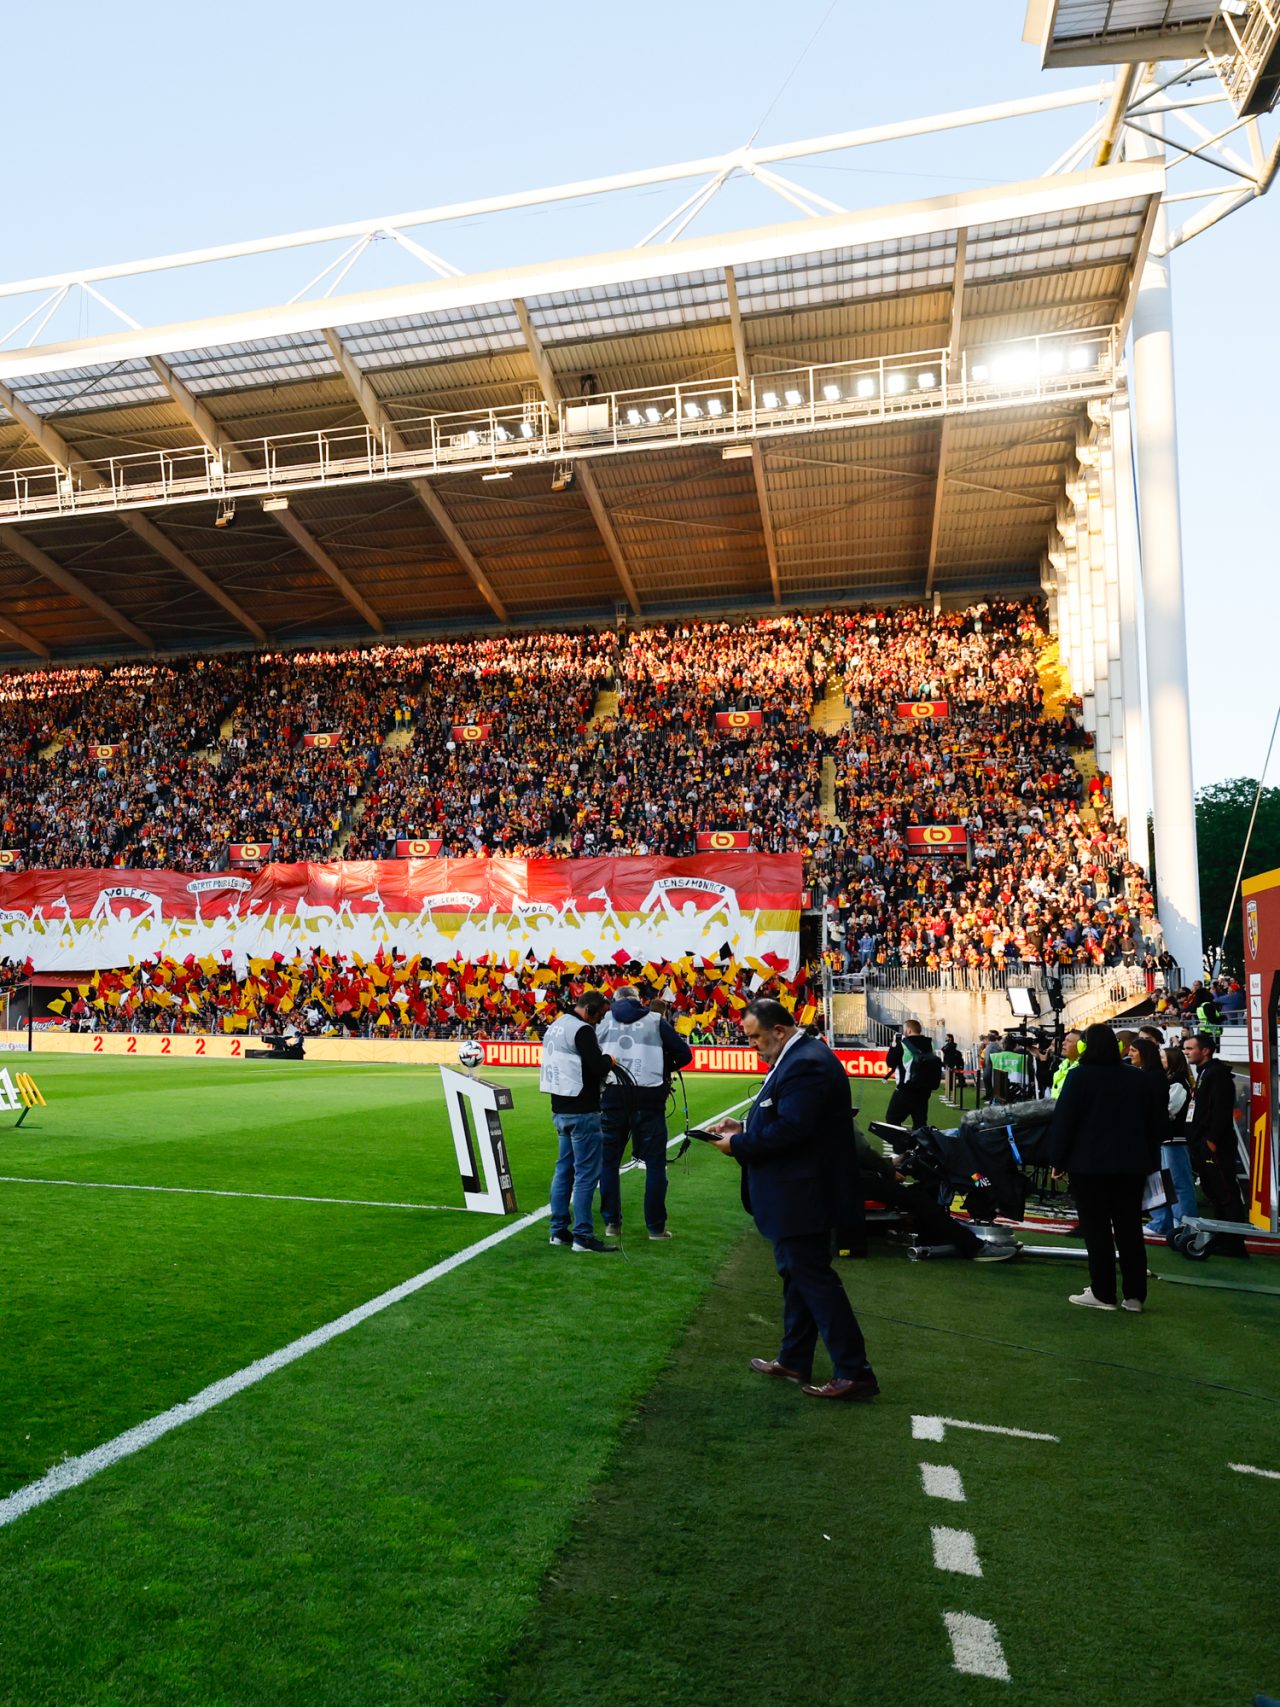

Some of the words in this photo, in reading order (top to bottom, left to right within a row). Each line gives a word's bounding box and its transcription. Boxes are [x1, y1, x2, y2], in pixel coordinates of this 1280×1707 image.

[105, 888, 137, 897] WOLF
[140, 891, 150, 901] 17
[518, 904, 552, 914] WOLF
[93, 1035, 104, 1052] 2
[127, 1036, 137, 1053] 2
[161, 1037, 171, 1054] 2
[195, 1038, 206, 1055] 2
[230, 1039, 241, 1056] 2
[486, 1044, 543, 1064] PUMA
[694, 1049, 759, 1071] PUMA
